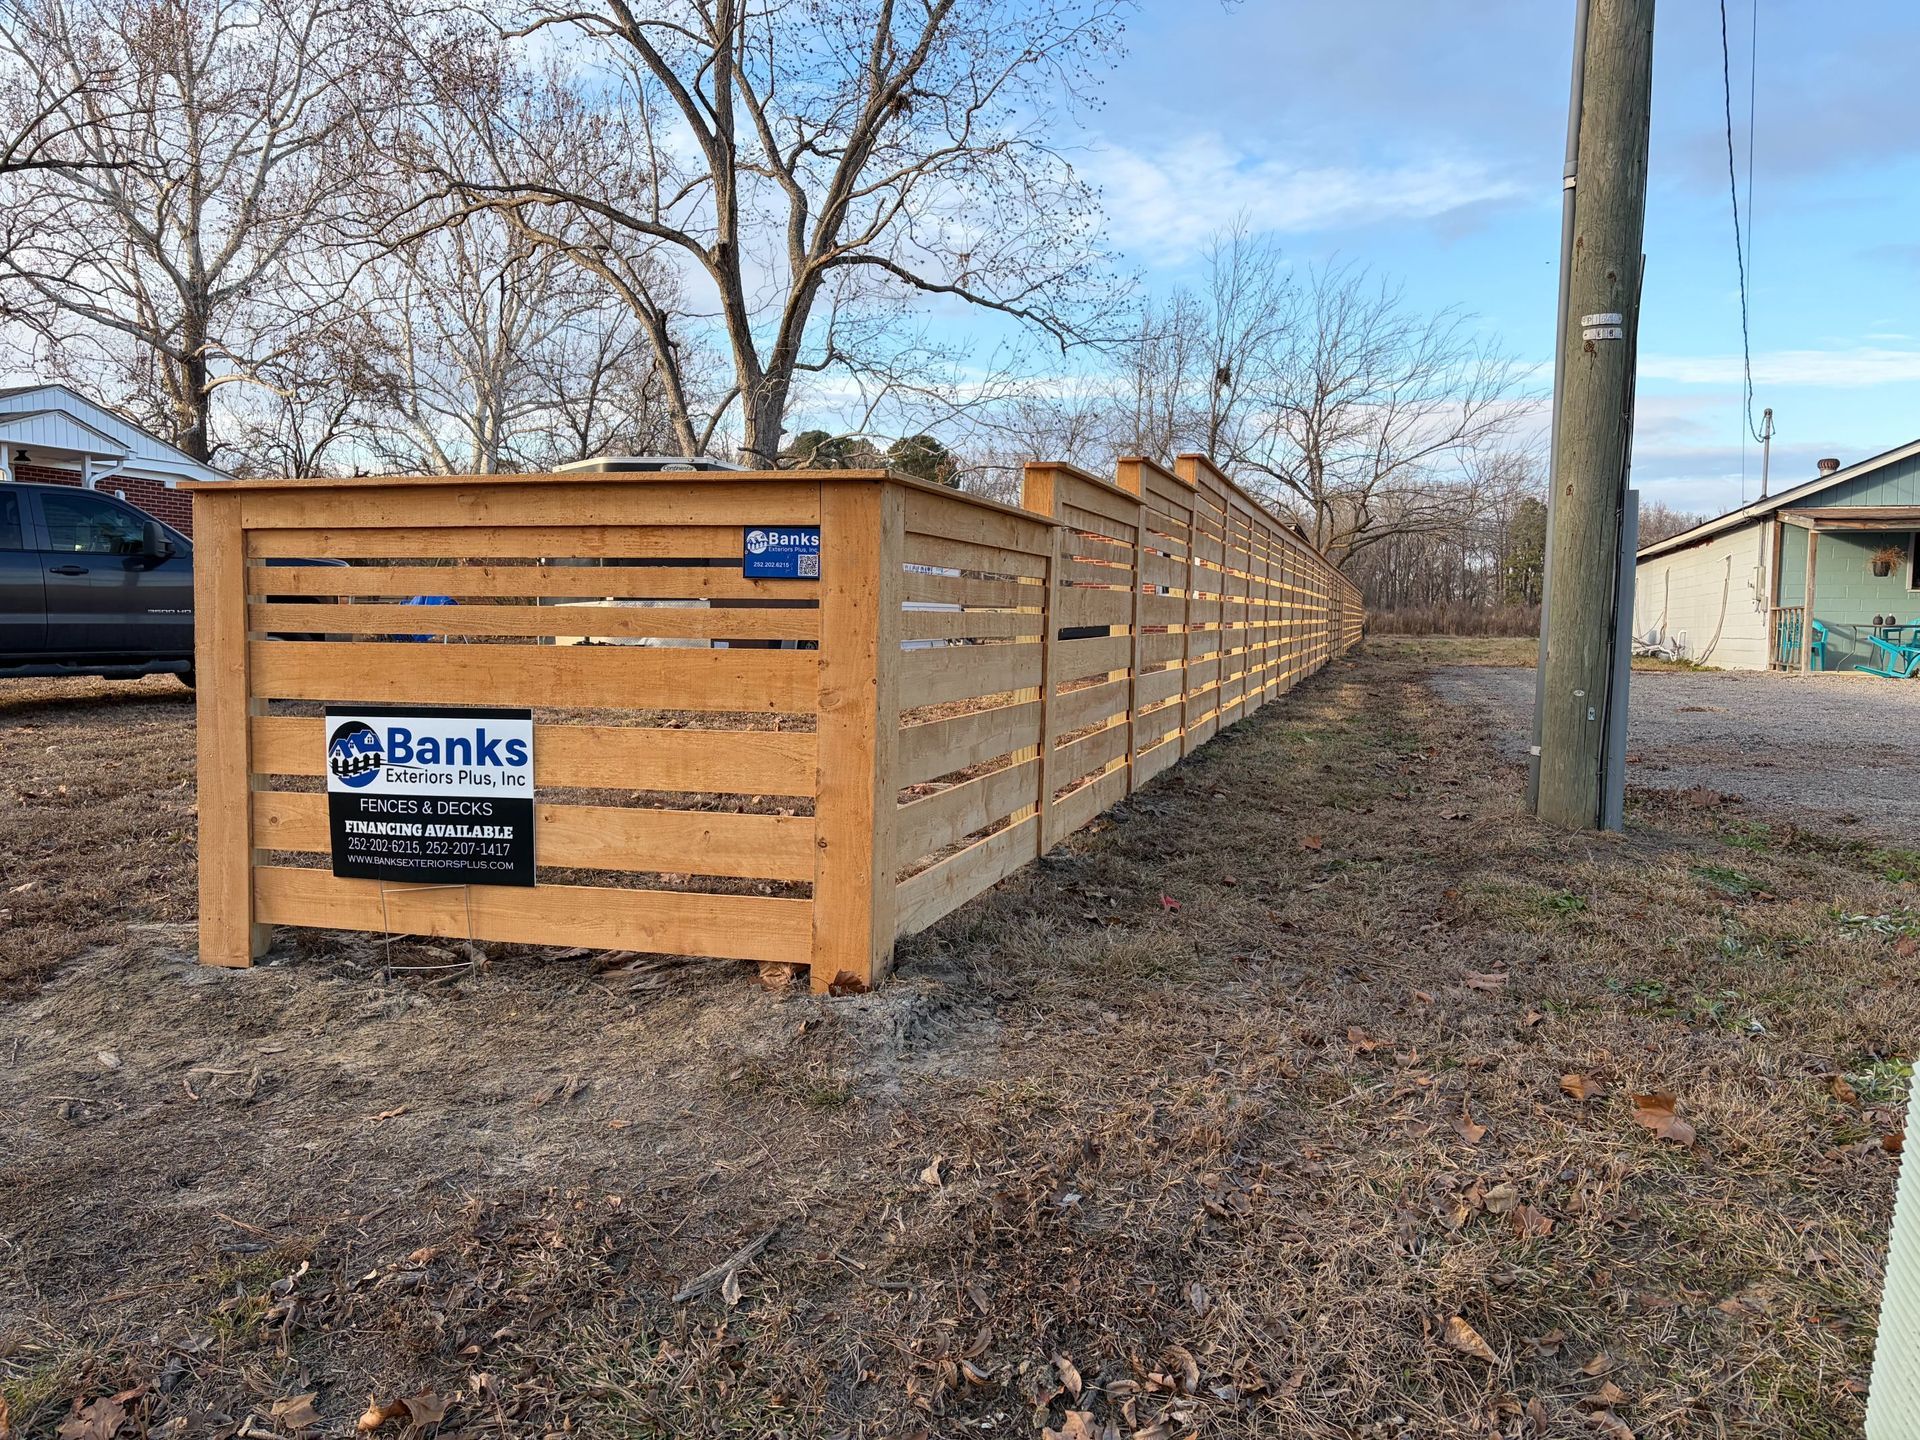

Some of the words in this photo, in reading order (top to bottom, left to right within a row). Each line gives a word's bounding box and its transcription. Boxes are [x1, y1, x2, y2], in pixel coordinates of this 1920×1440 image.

[768, 532, 820, 546] Banks
[387, 727, 528, 767] Banks
[386, 768, 453, 785] Exteriors
[458, 770, 496, 788] Plus,
[502, 771, 526, 786] Inc
[360, 798, 418, 814] FENCES
[422, 801, 433, 815] &
[437, 801, 493, 816] DECKS
[344, 820, 423, 837] FINANCING
[424, 824, 514, 840] AVAILABLE
[348, 836, 422, 855] 252-202-6215,
[425, 841, 511, 856] 252-207-1417
[347, 854, 514, 870] WWW.BANKSEXTERIORSPLUS.COM
